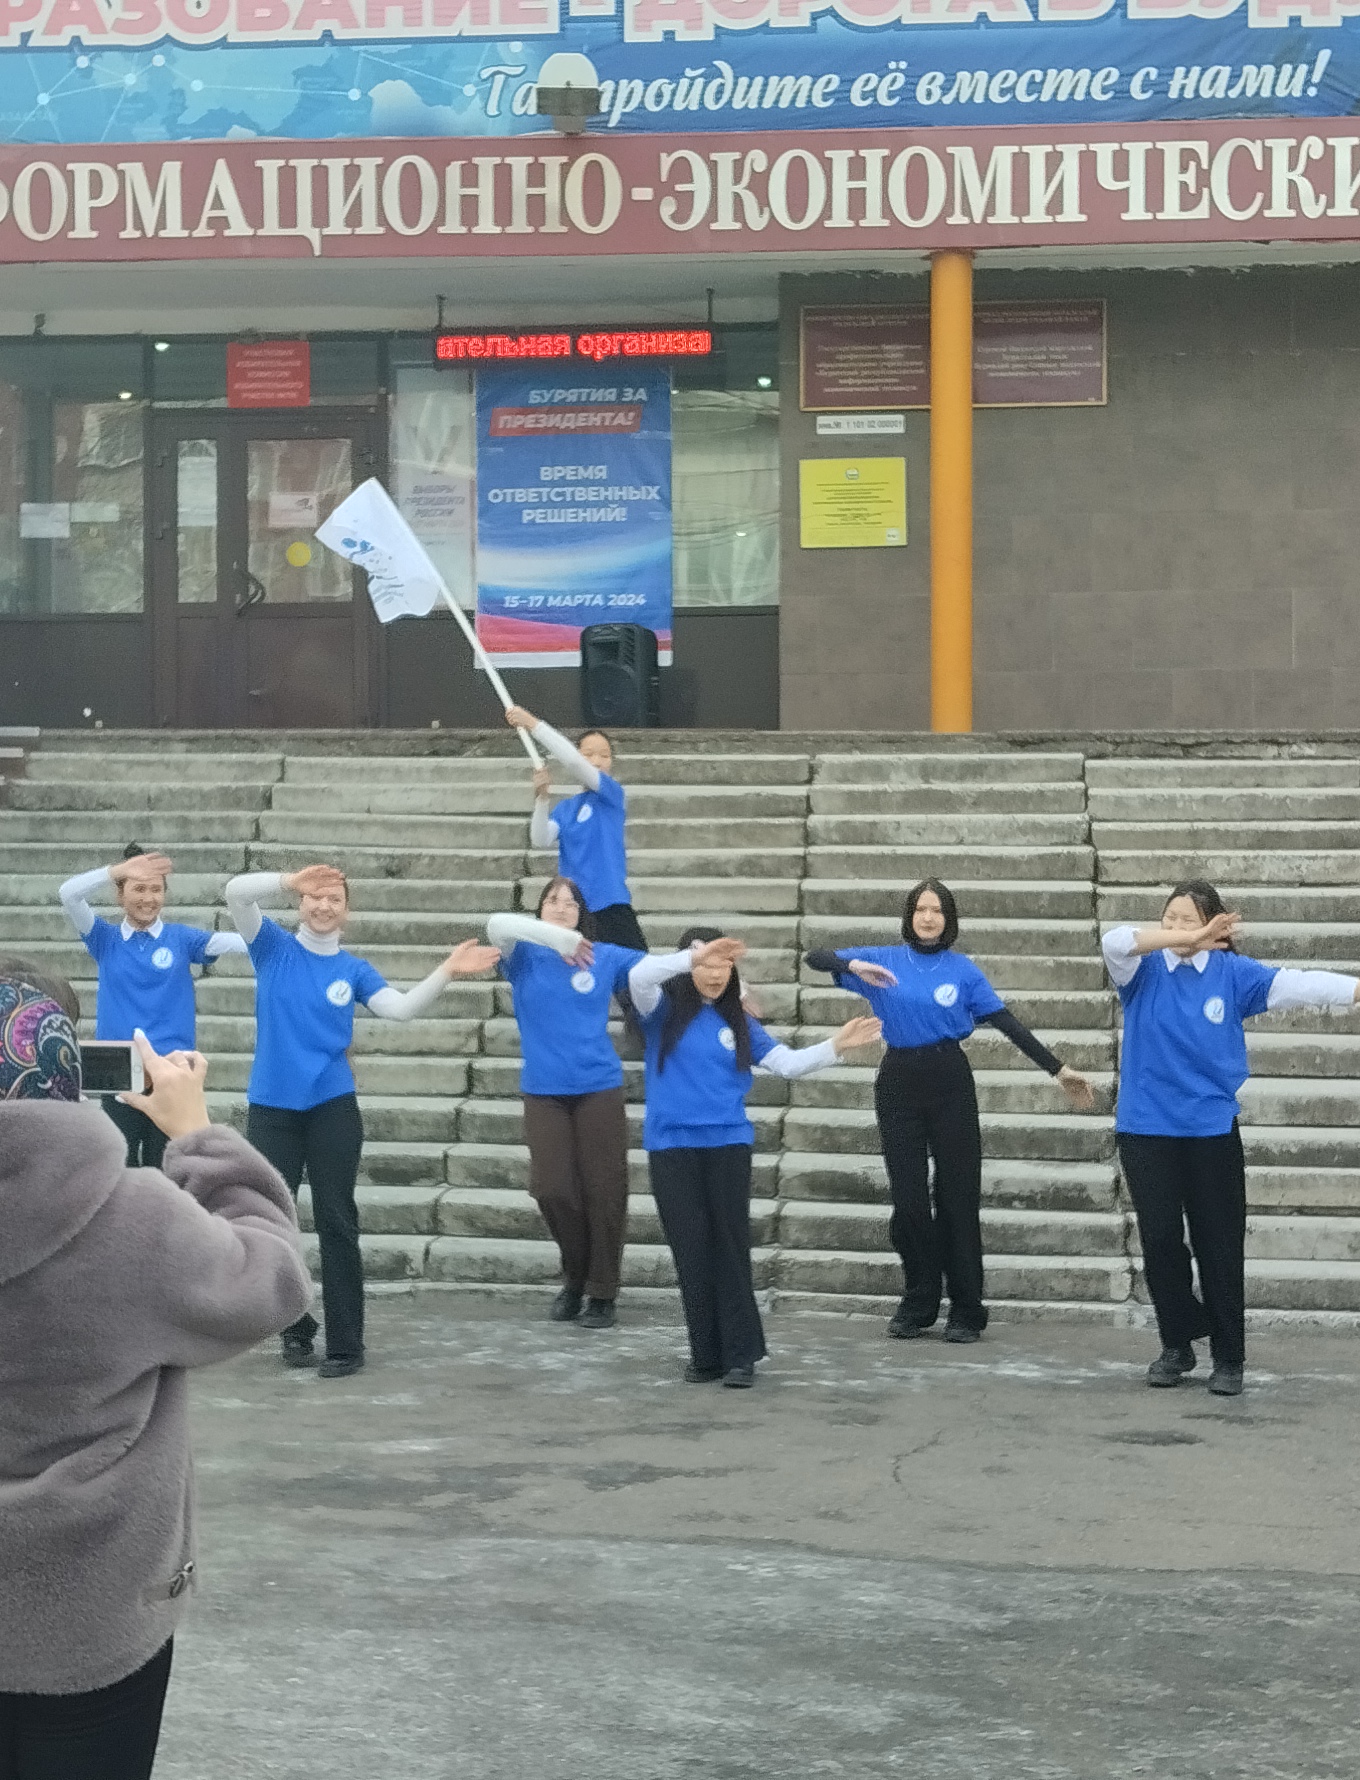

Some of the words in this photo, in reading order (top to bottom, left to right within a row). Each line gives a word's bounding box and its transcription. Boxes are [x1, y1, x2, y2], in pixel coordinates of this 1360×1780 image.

[850, 60, 908, 107] её
[916, 67, 1117, 106] вместе
[1129, 68, 1157, 100] с
[1167, 48, 1332, 98] нами!
[528, 388, 619, 404] БУРЯТИЯ
[622, 387, 648, 402] ЗА
[497, 412, 636, 430] ПРЕЗИДЕНТА!
[540, 465, 608, 481] ВРЕМЯ
[488, 485, 662, 504] ОТВЕТСТВЕННЫХ
[522, 504, 628, 524] РЕШЕНИЙ!
[547, 594, 604, 607] МАРТА
[607, 593, 646, 606] 2024
